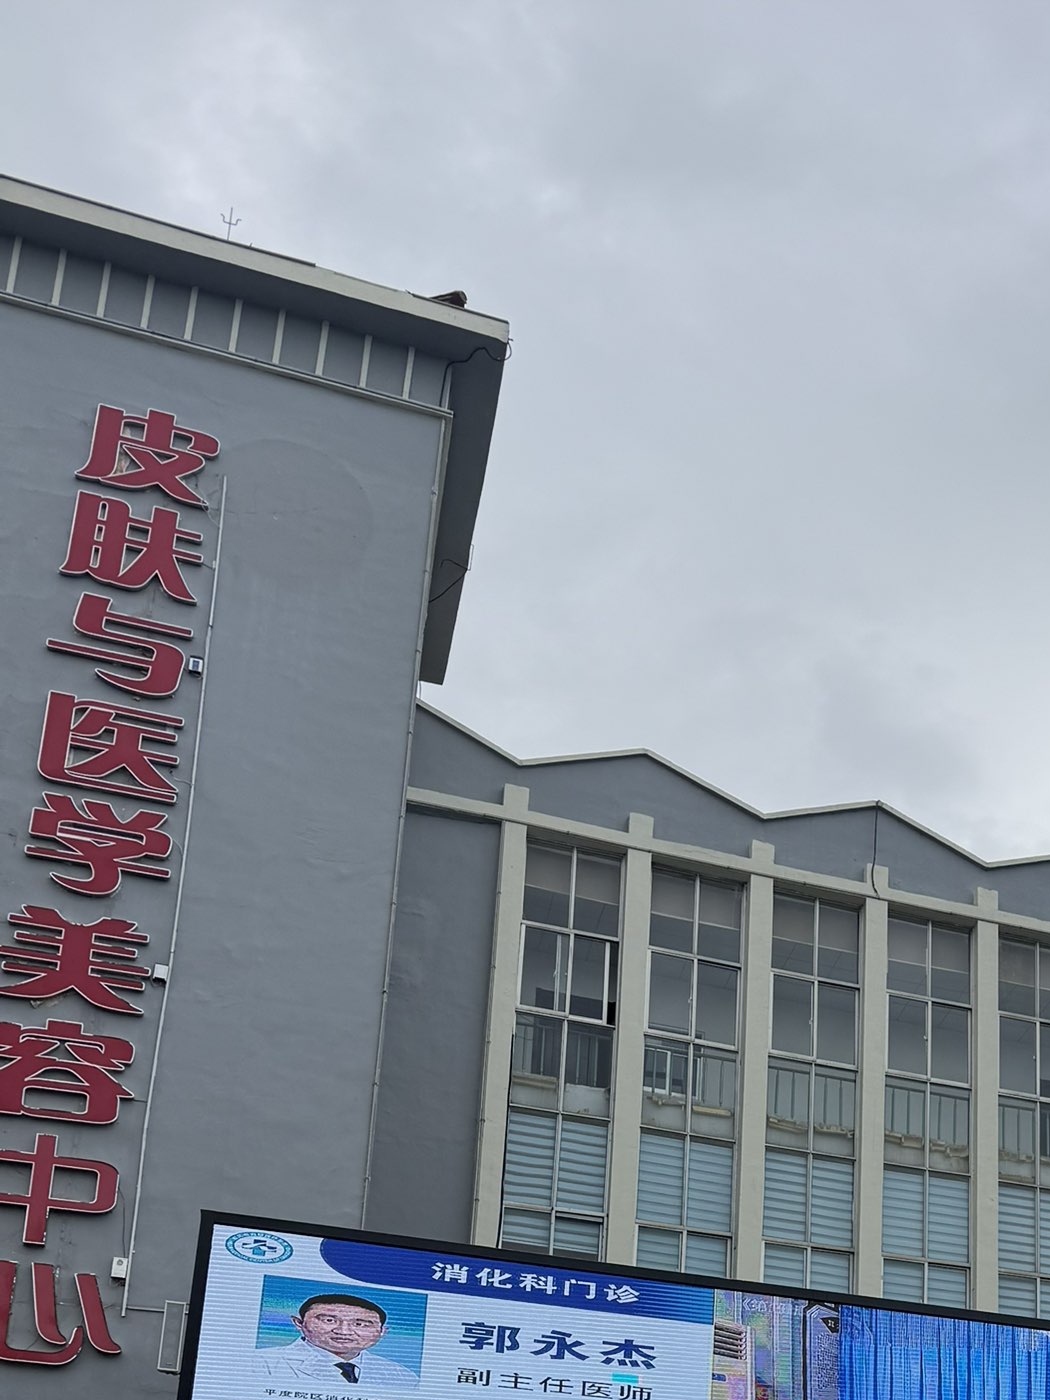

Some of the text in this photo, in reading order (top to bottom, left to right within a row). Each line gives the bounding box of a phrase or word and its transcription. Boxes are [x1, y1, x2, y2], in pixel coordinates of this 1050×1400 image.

[0, 402, 220, 1366] 皮肤与医学美容中心
[431, 1261, 641, 1304] 消化科门诊
[458, 1321, 658, 1370] 郭永杰
